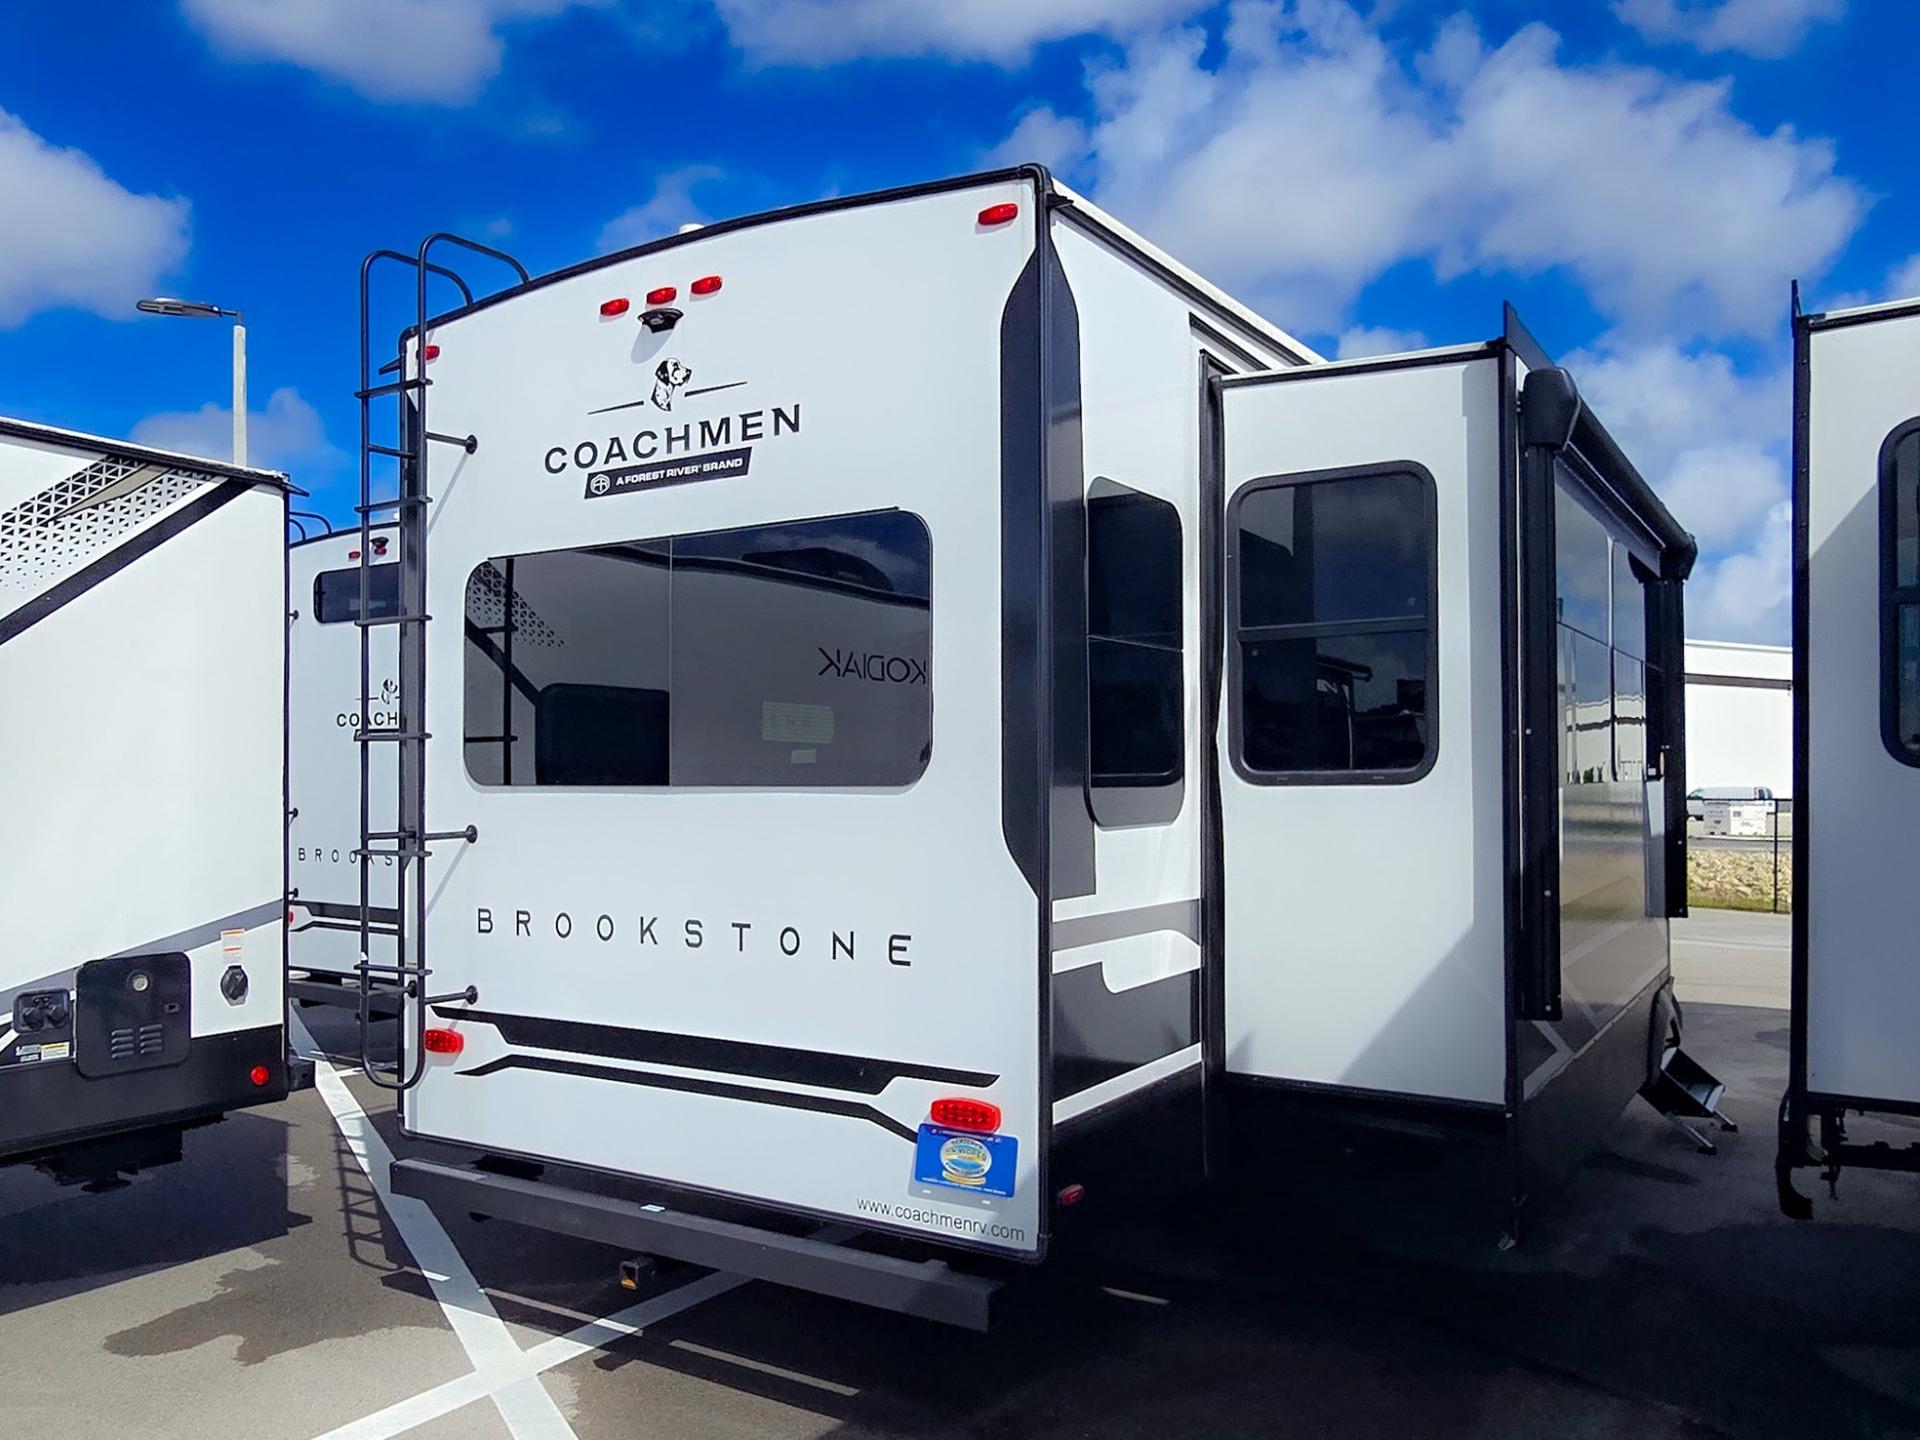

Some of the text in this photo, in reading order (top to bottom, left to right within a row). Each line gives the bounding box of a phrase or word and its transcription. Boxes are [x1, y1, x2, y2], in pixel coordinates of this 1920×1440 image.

[544, 403, 801, 474] COACHMEN
[615, 457, 744, 487] A FOREST RIVER BRAND
[336, 711, 398, 727] COCH
[477, 907, 912, 967] BROOKSTONE
[856, 1197, 1025, 1242] www.coachmenrv.com
